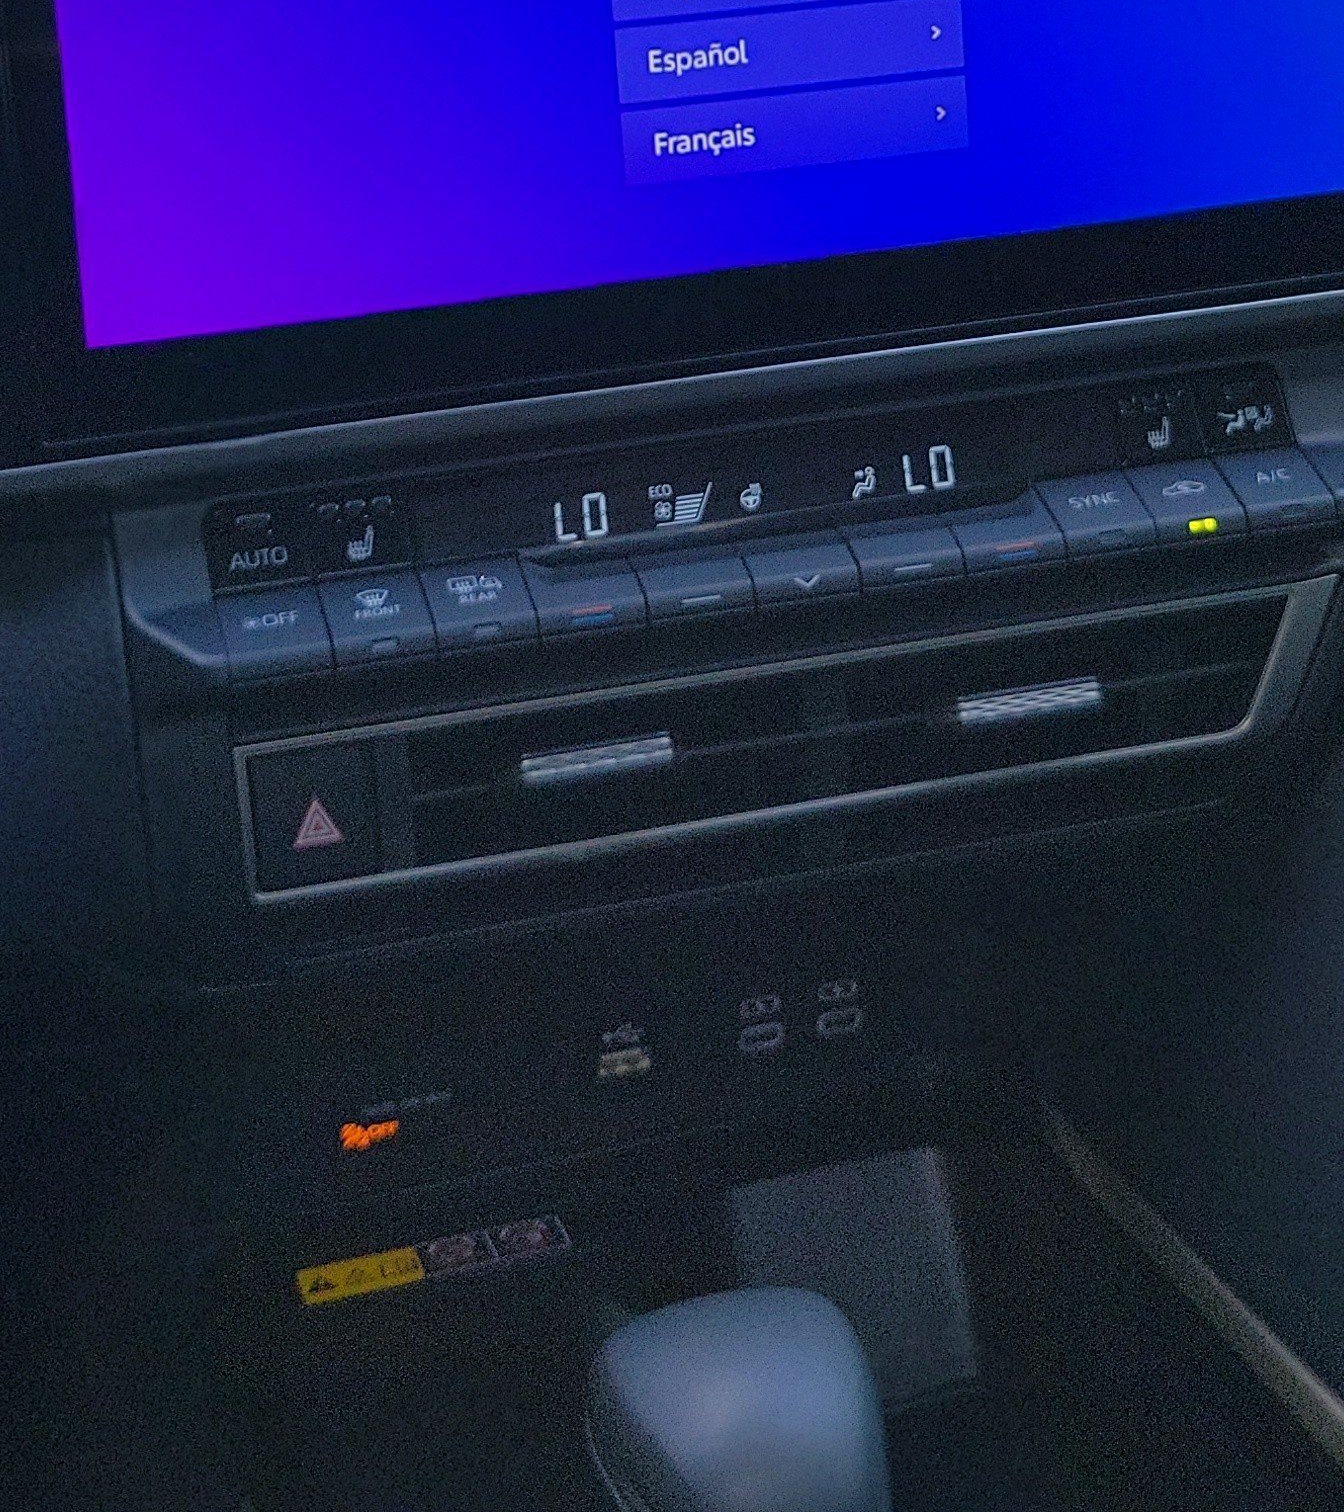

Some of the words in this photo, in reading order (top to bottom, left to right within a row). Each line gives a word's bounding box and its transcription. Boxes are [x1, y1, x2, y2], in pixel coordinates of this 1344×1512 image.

[647, 39, 749, 76] Español
[653, 122, 756, 156] Français
[902, 444, 955, 495] LO
[1257, 467, 1290, 485] A/C
[648, 483, 673, 500] ECO
[1068, 491, 1121, 509] SYNC
[554, 492, 609, 540] LO
[230, 546, 288, 573] AUTO
[459, 591, 497, 604] REAR
[263, 611, 299, 627] OFF
[355, 604, 401, 619] FRONT
